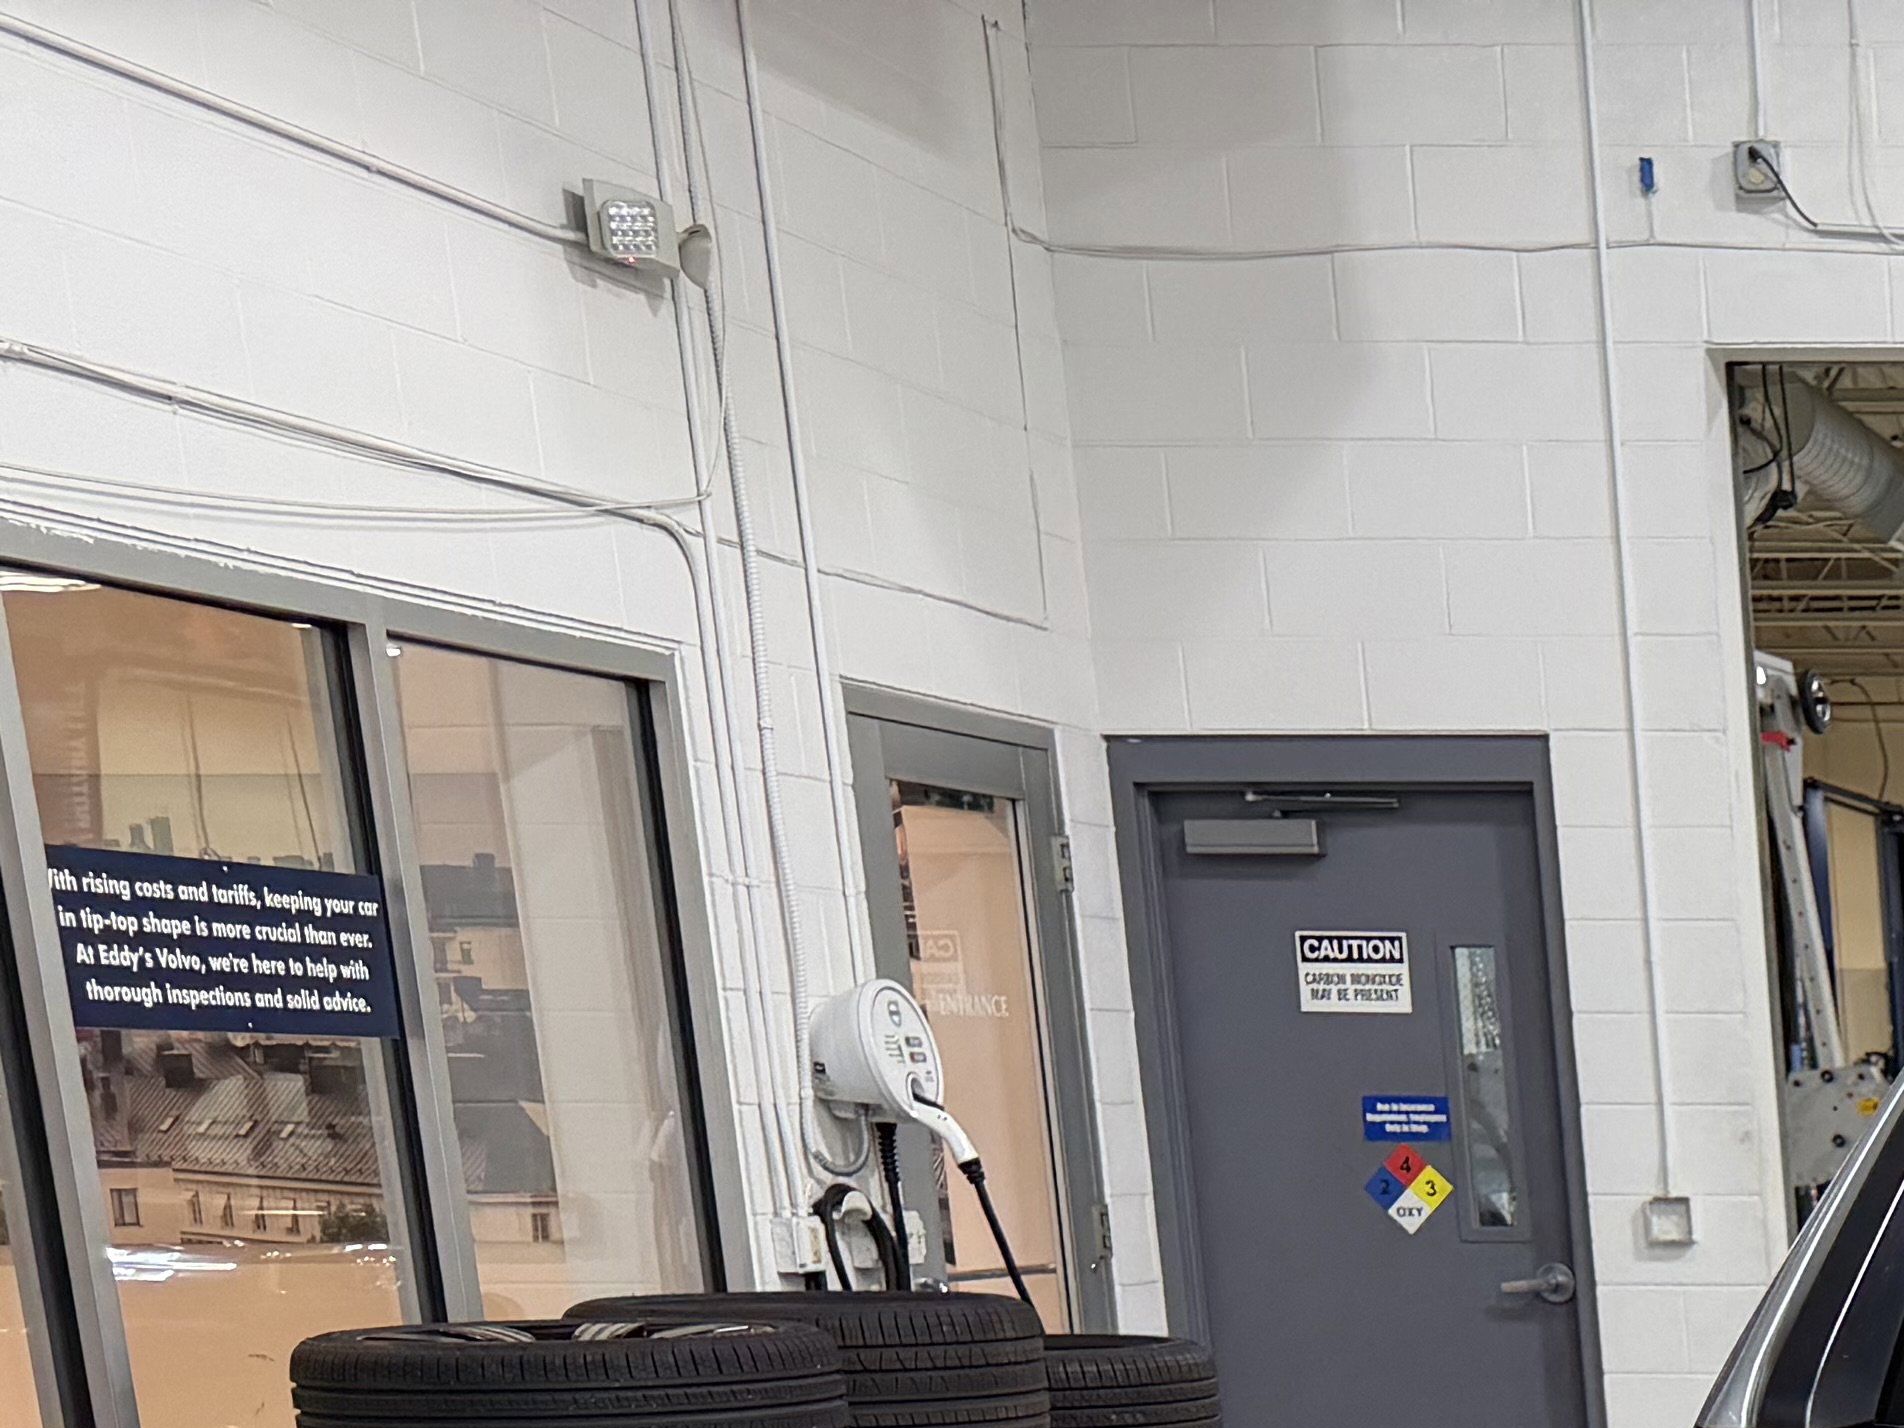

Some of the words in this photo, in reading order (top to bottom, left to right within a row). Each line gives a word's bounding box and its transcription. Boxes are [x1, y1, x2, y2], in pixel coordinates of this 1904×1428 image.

[82, 871, 130, 900] rising
[135, 879, 174, 899] costs
[177, 881, 208, 902] and
[212, 884, 261, 910] tariffs,
[264, 887, 322, 916] keeping
[325, 898, 355, 917] your
[358, 900, 379, 917] car
[58, 905, 76, 927] in
[80, 907, 138, 937] tip-top
[142, 911, 191, 939] shape
[194, 915, 208, 937] is
[212, 921, 251, 940] more
[255, 922, 300, 944] crucial
[304, 924, 336, 946] than
[340, 932, 372, 948] ever.
[1303, 938, 1400, 960] CAUTION
[76, 943, 95, 965] At
[98, 944, 153, 972] Eddy's
[156, 947, 206, 974] Volvo,
[208, 953, 248, 973] we're
[251, 953, 286, 975] here
[289, 958, 303, 976] to
[306, 956, 337, 983] help
[340, 960, 370, 980] with
[86, 978, 163, 1008] thorough
[165, 983, 251, 1010] inspections
[255, 988, 283, 1008] and
[287, 989, 320, 1010] solid
[323, 991, 372, 1013] advice.
[940, 994, 1009, 1017] ENTRANCE
[1400, 1156, 1411, 1173] 4
[1380, 1179, 1390, 1195] 2
[1425, 1180, 1437, 1197] 3
[1396, 1207, 1423, 1217] OXY
